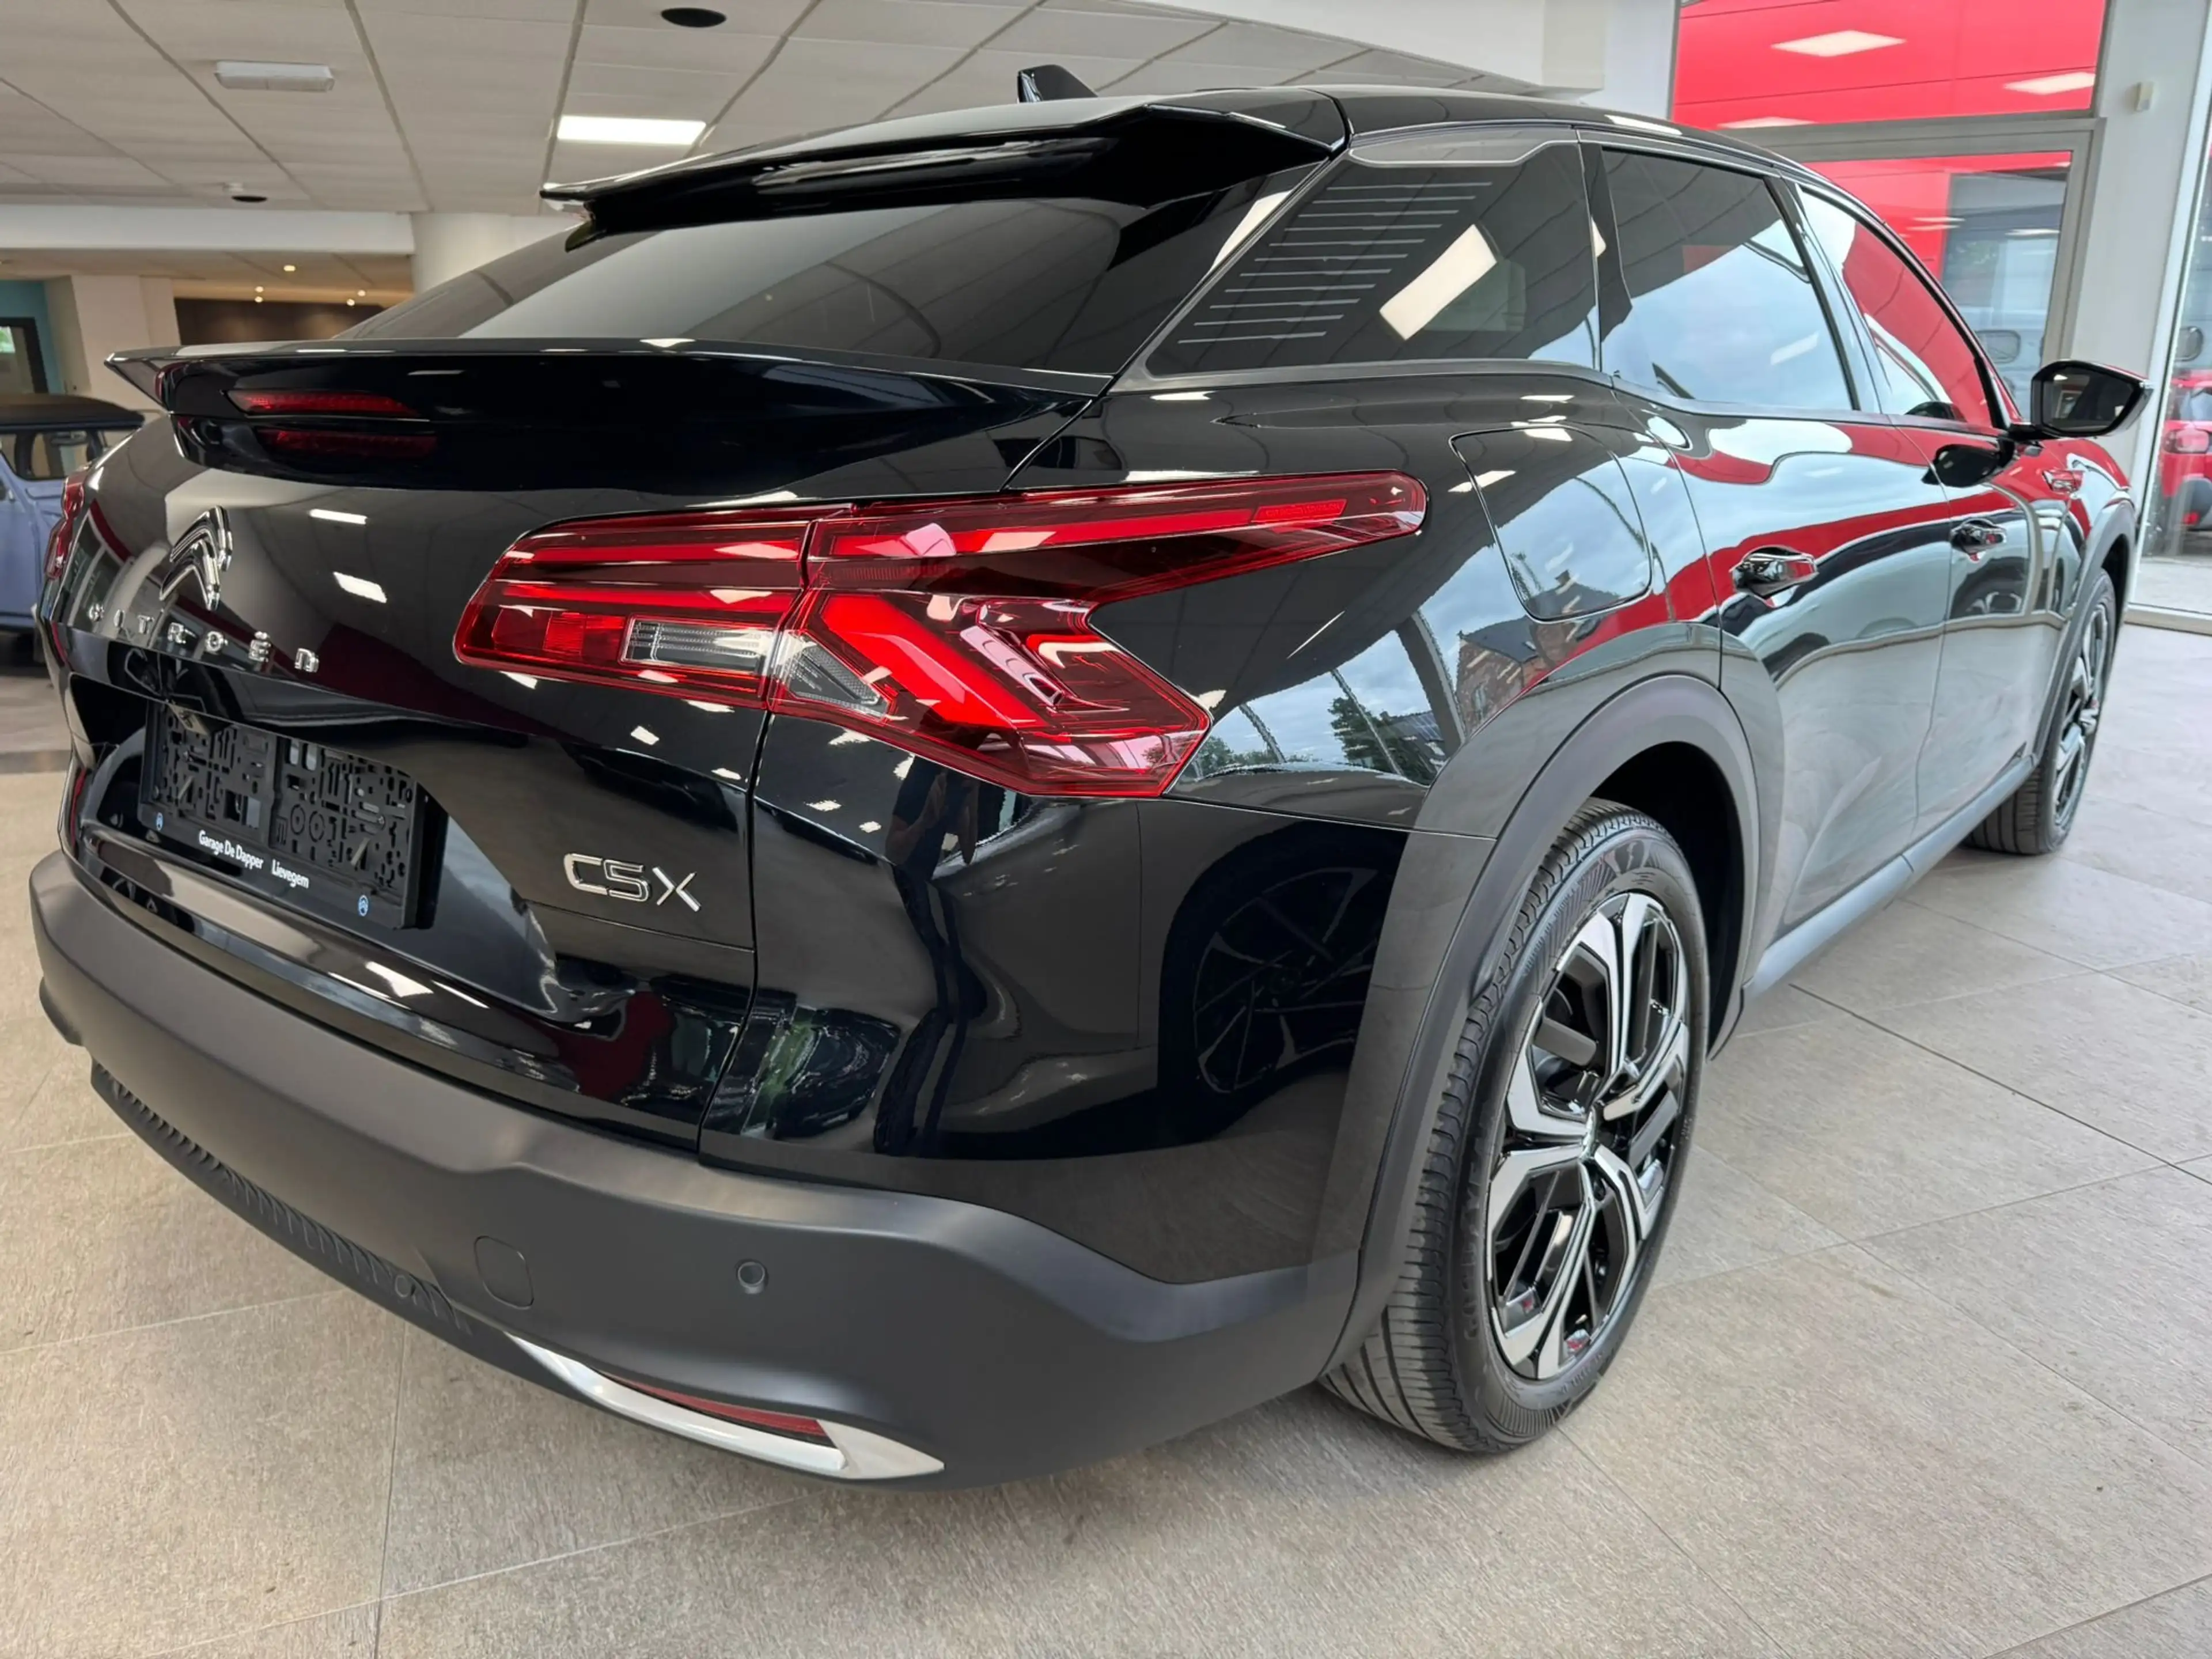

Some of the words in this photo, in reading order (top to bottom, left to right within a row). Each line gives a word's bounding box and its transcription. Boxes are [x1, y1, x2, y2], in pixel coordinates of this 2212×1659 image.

[199, 830, 224, 855] Garage
[224, 839, 235, 858] De
[236, 844, 264, 869] Dapper
[271, 859, 309, 889] Lievegem
